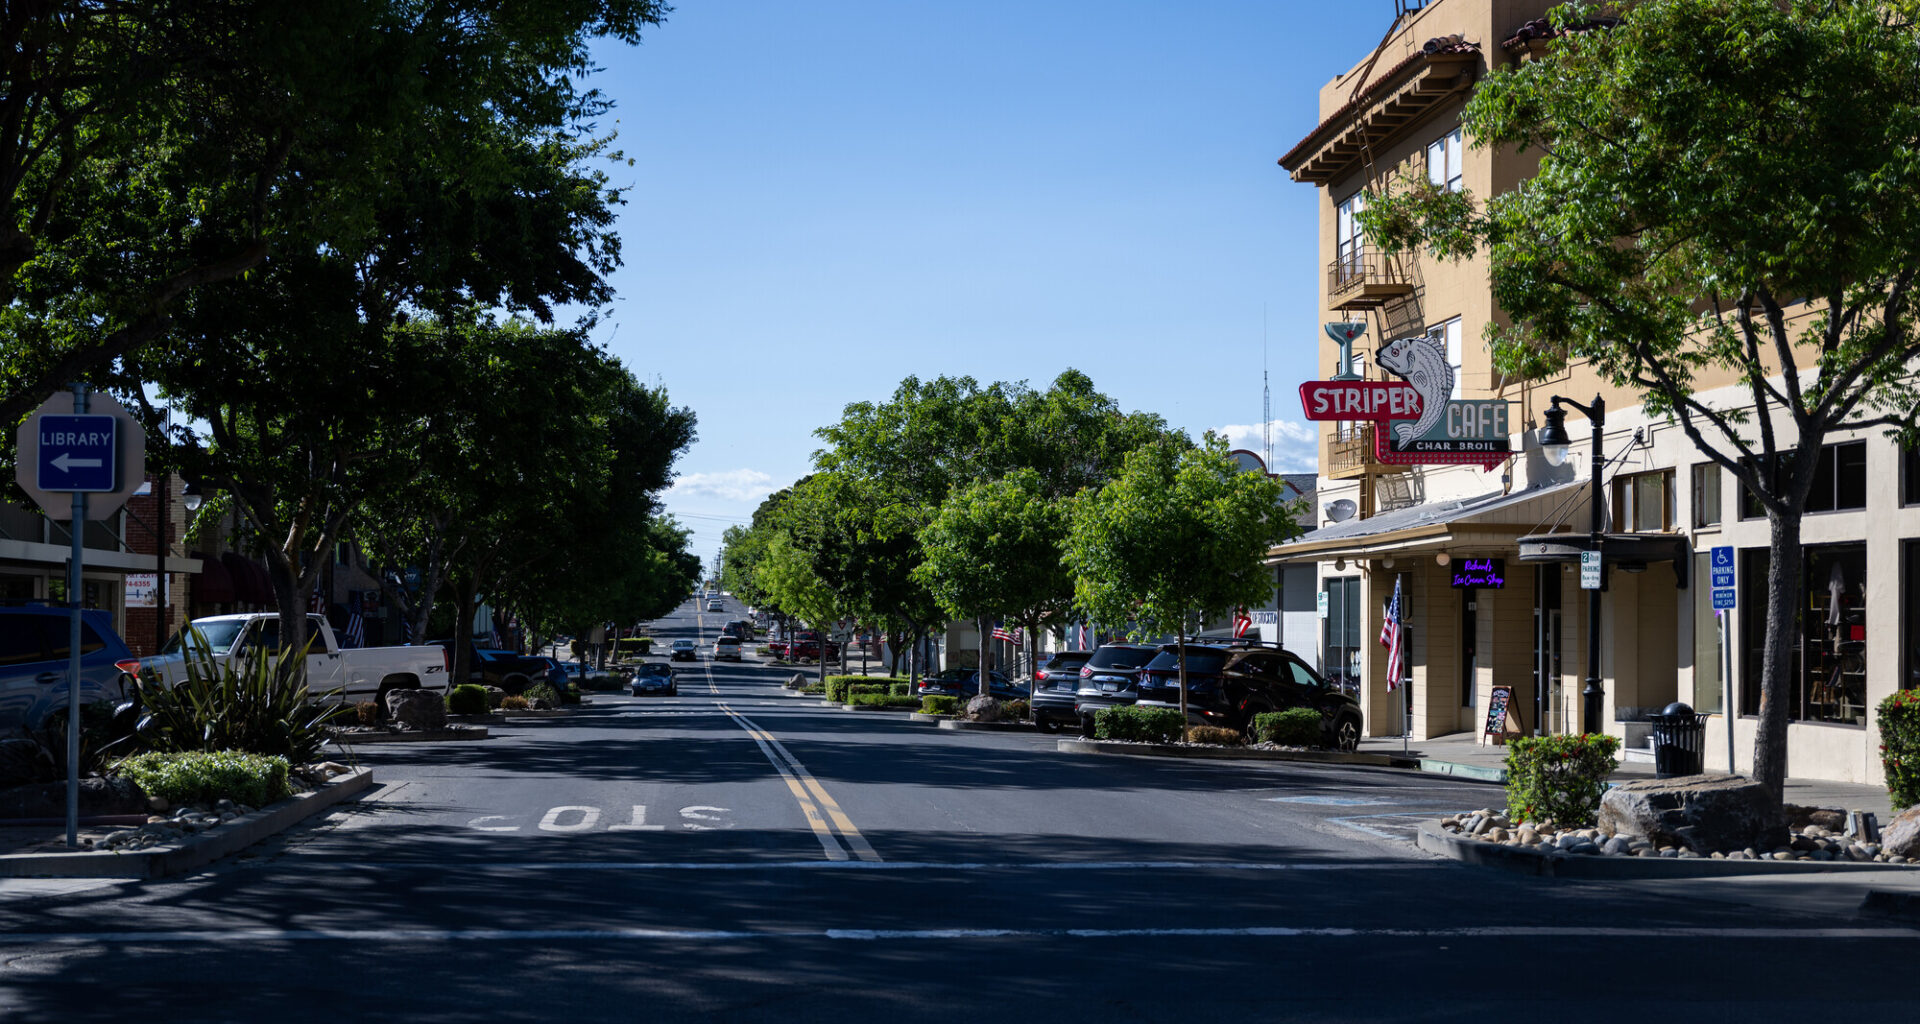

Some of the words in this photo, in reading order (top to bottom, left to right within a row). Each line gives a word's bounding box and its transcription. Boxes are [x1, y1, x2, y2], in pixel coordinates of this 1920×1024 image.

[1313, 387, 1421, 415] STRIPER
[1447, 403, 1505, 438] CAFE
[41, 432, 111, 446] LIBRARY
[1416, 441, 1451, 450] CHAR
[1459, 441, 1495, 450] BROIL
[1583, 553, 1588, 562] 2
[1713, 566, 1734, 575] PARKING
[1452, 574, 1464, 586] Ice
[1465, 574, 1485, 586] Cream
[1486, 573, 1504, 588] Shop
[1716, 576, 1730, 584] ONLY
